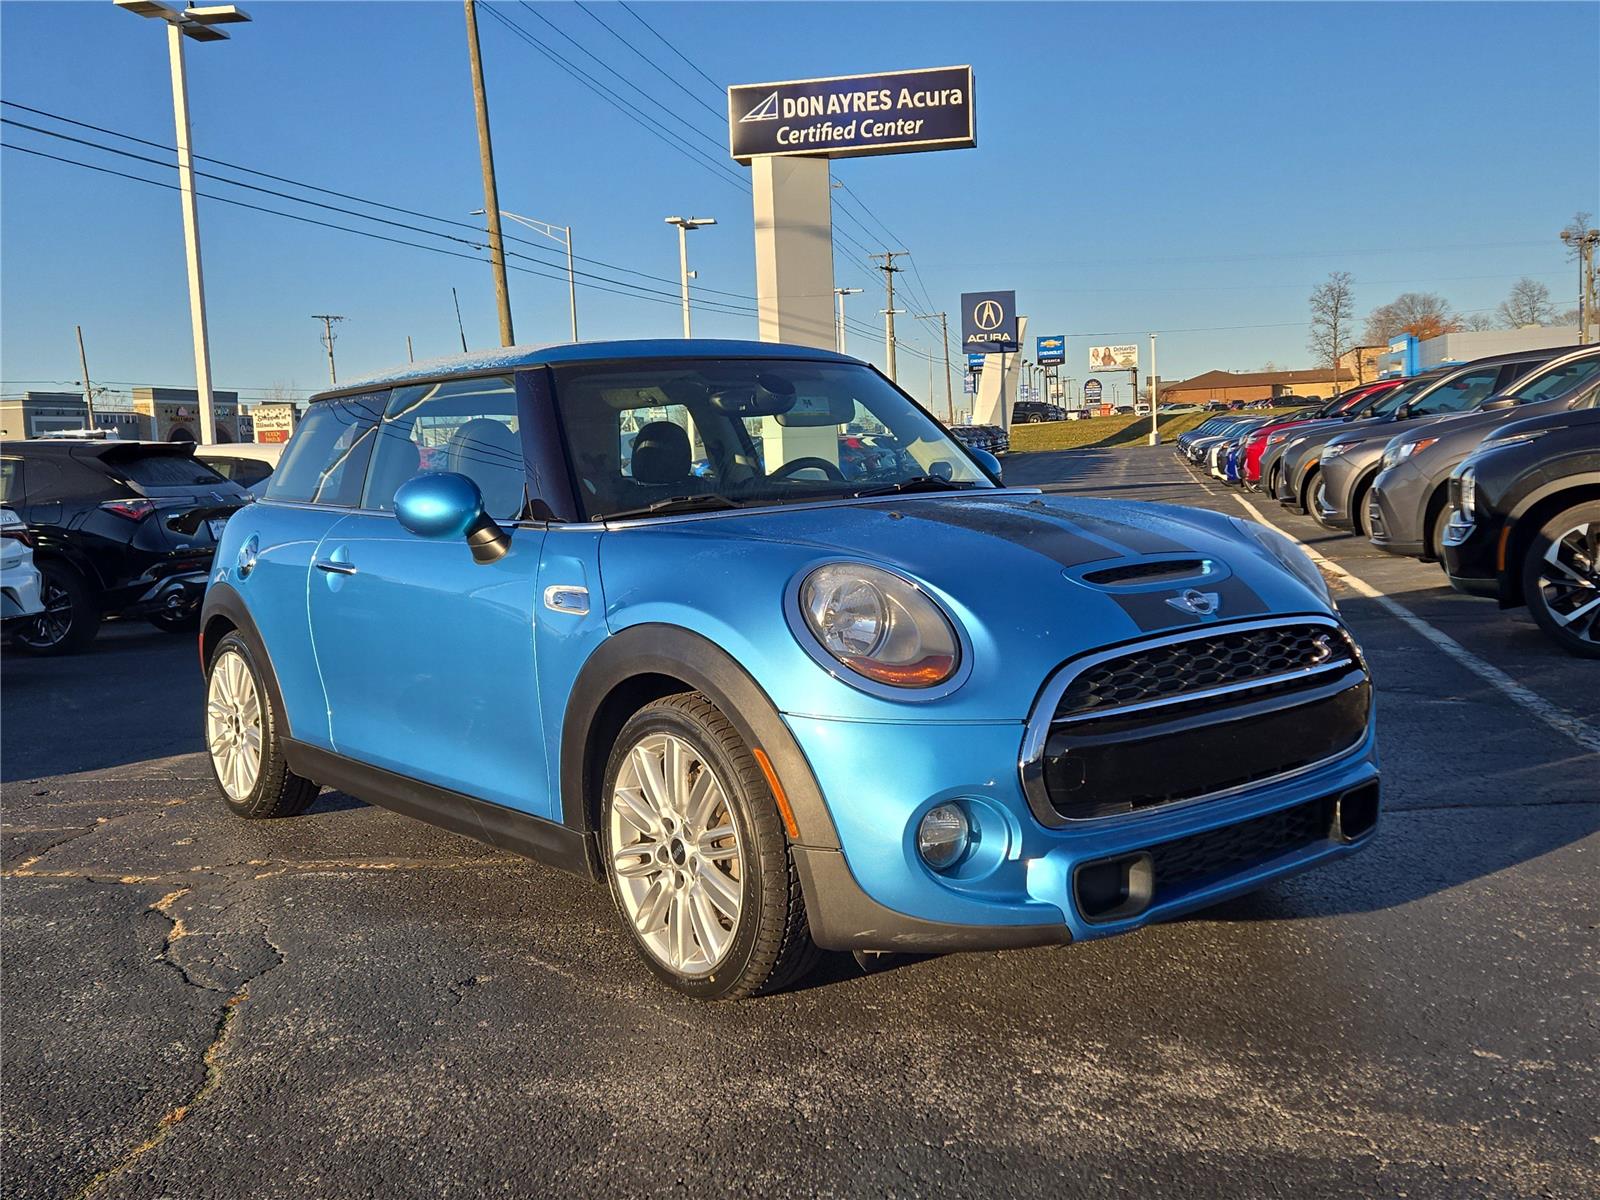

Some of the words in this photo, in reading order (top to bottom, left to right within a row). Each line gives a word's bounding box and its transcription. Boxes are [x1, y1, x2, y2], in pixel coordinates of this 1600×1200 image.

[783, 96, 824, 118] DON
[827, 89, 893, 115] AYRES
[896, 88, 963, 109] Acura
[776, 119, 856, 145] Certified
[860, 118, 924, 138] Center
[967, 332, 1011, 343] ACURA
